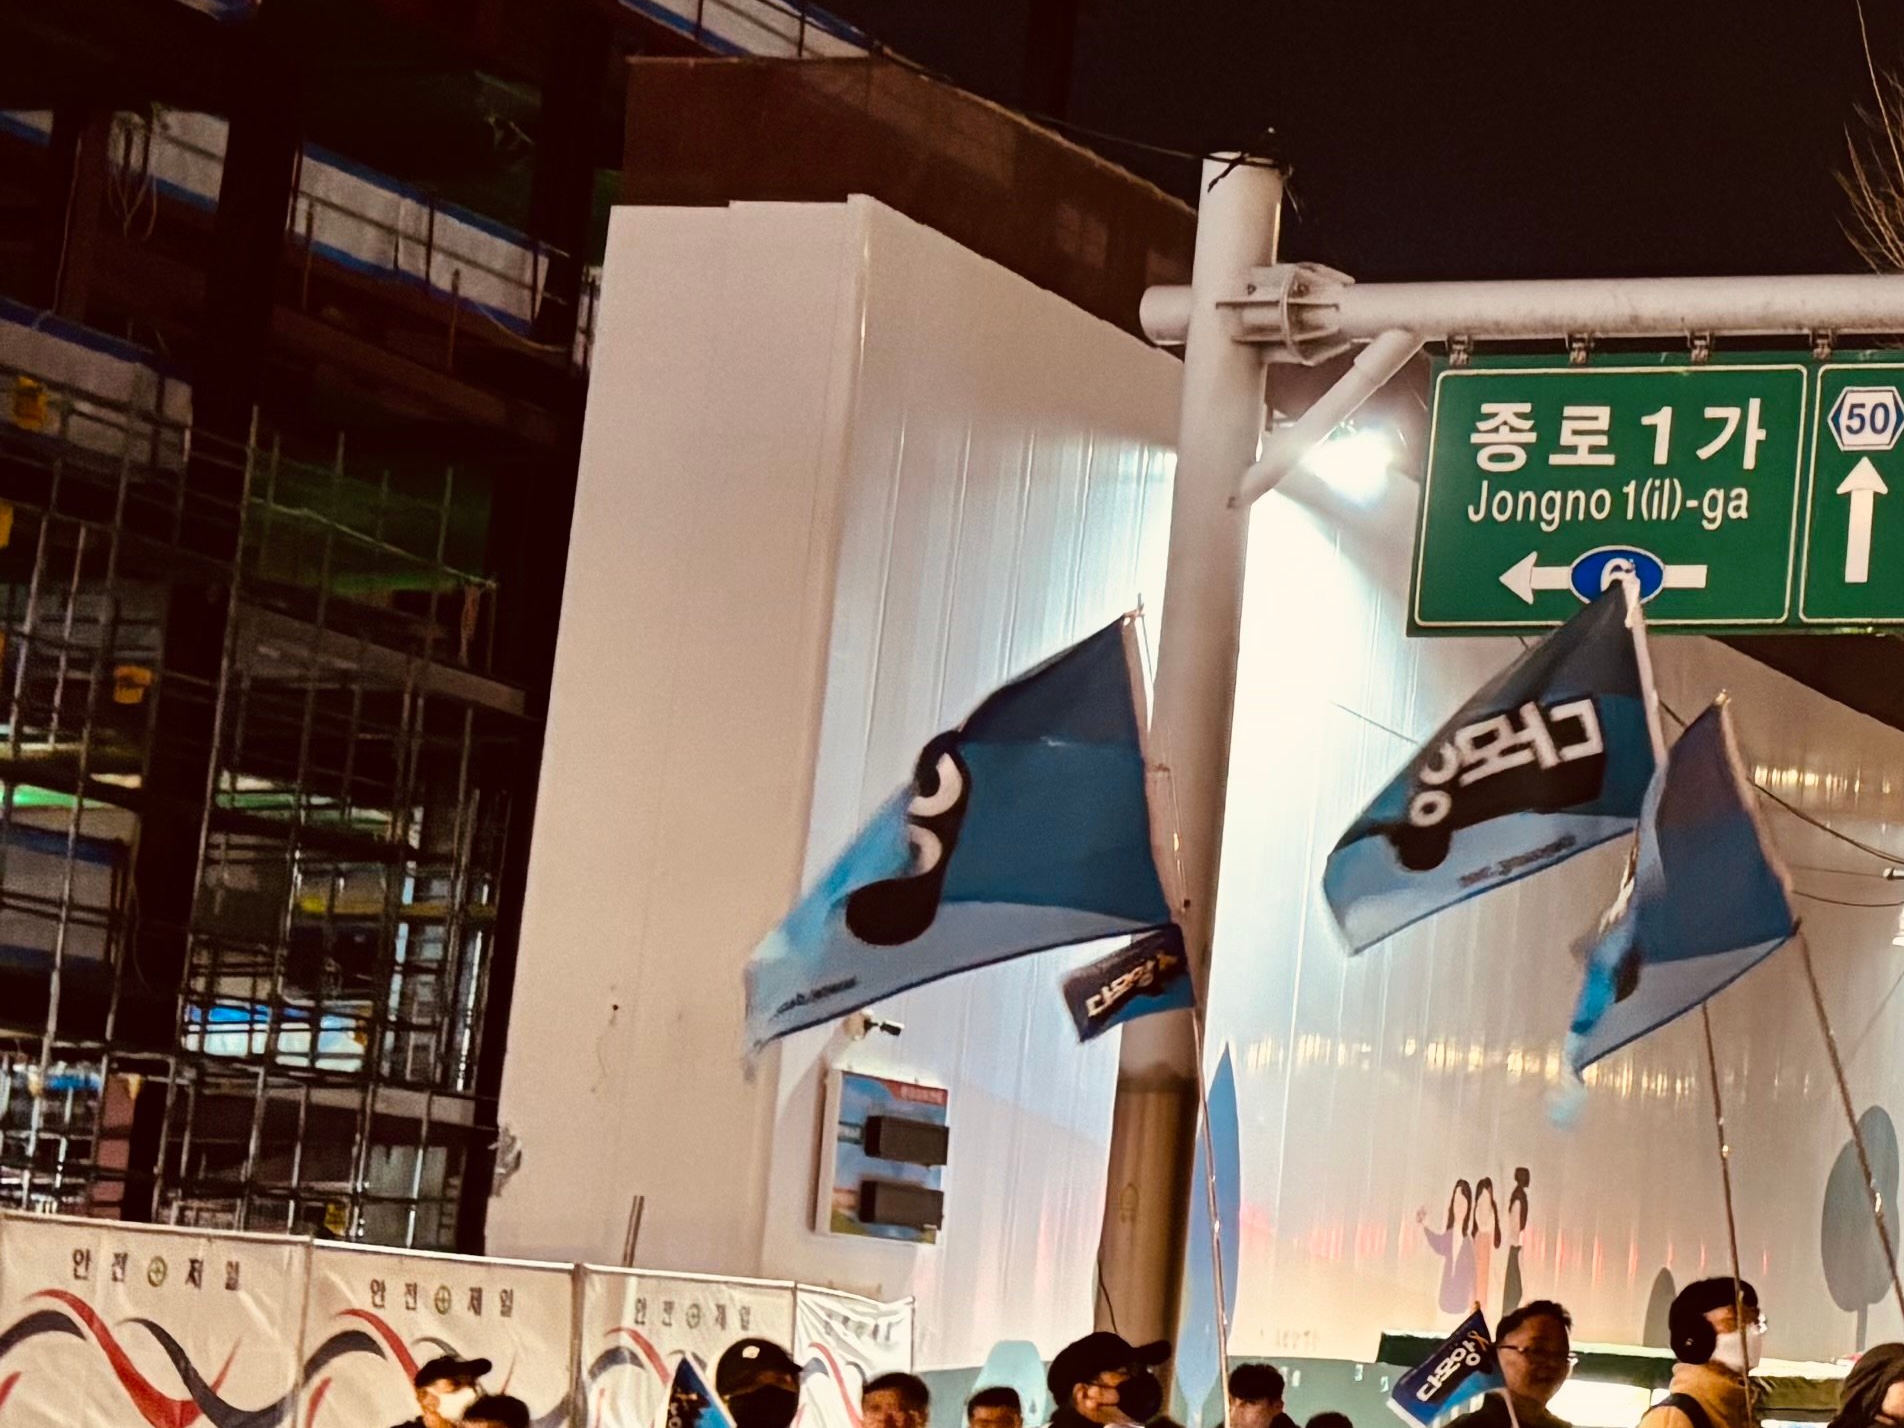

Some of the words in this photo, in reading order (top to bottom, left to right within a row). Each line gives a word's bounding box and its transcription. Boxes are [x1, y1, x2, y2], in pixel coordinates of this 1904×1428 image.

[1845, 402, 1890, 435] 50
[1467, 479, 1612, 532] Jongno
[1622, 477, 1749, 531] 1(il)-ga
[73, 1248, 128, 1282] 안전
[370, 1279, 418, 1311] 안전
[1416, 1340, 1482, 1402] 다모앙
